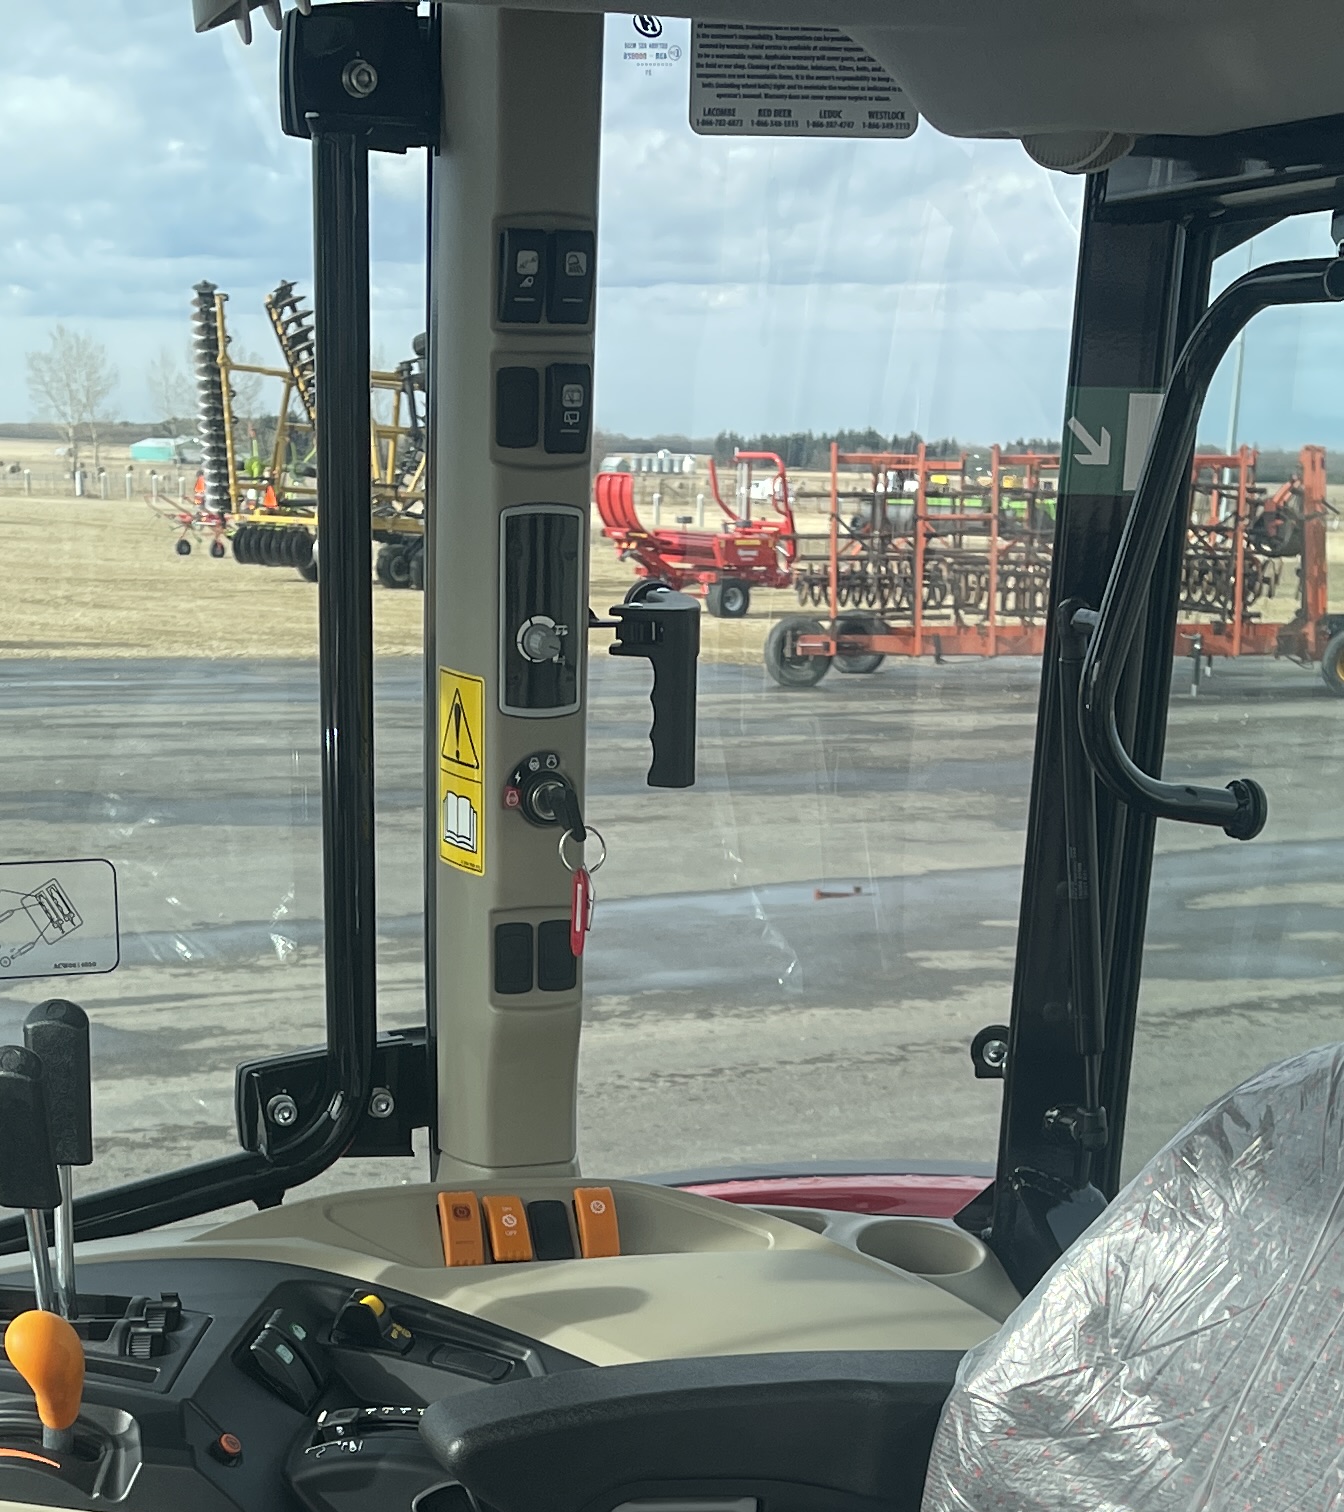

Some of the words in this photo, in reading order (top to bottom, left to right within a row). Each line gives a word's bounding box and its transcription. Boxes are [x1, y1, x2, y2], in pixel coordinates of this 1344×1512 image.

[703, 108, 736, 116] LACOMBE
[758, 109, 772, 117] RED
[774, 109, 792, 117] DEER
[819, 110, 842, 119] LEDUC
[868, 111, 905, 120] WESTLOCK
